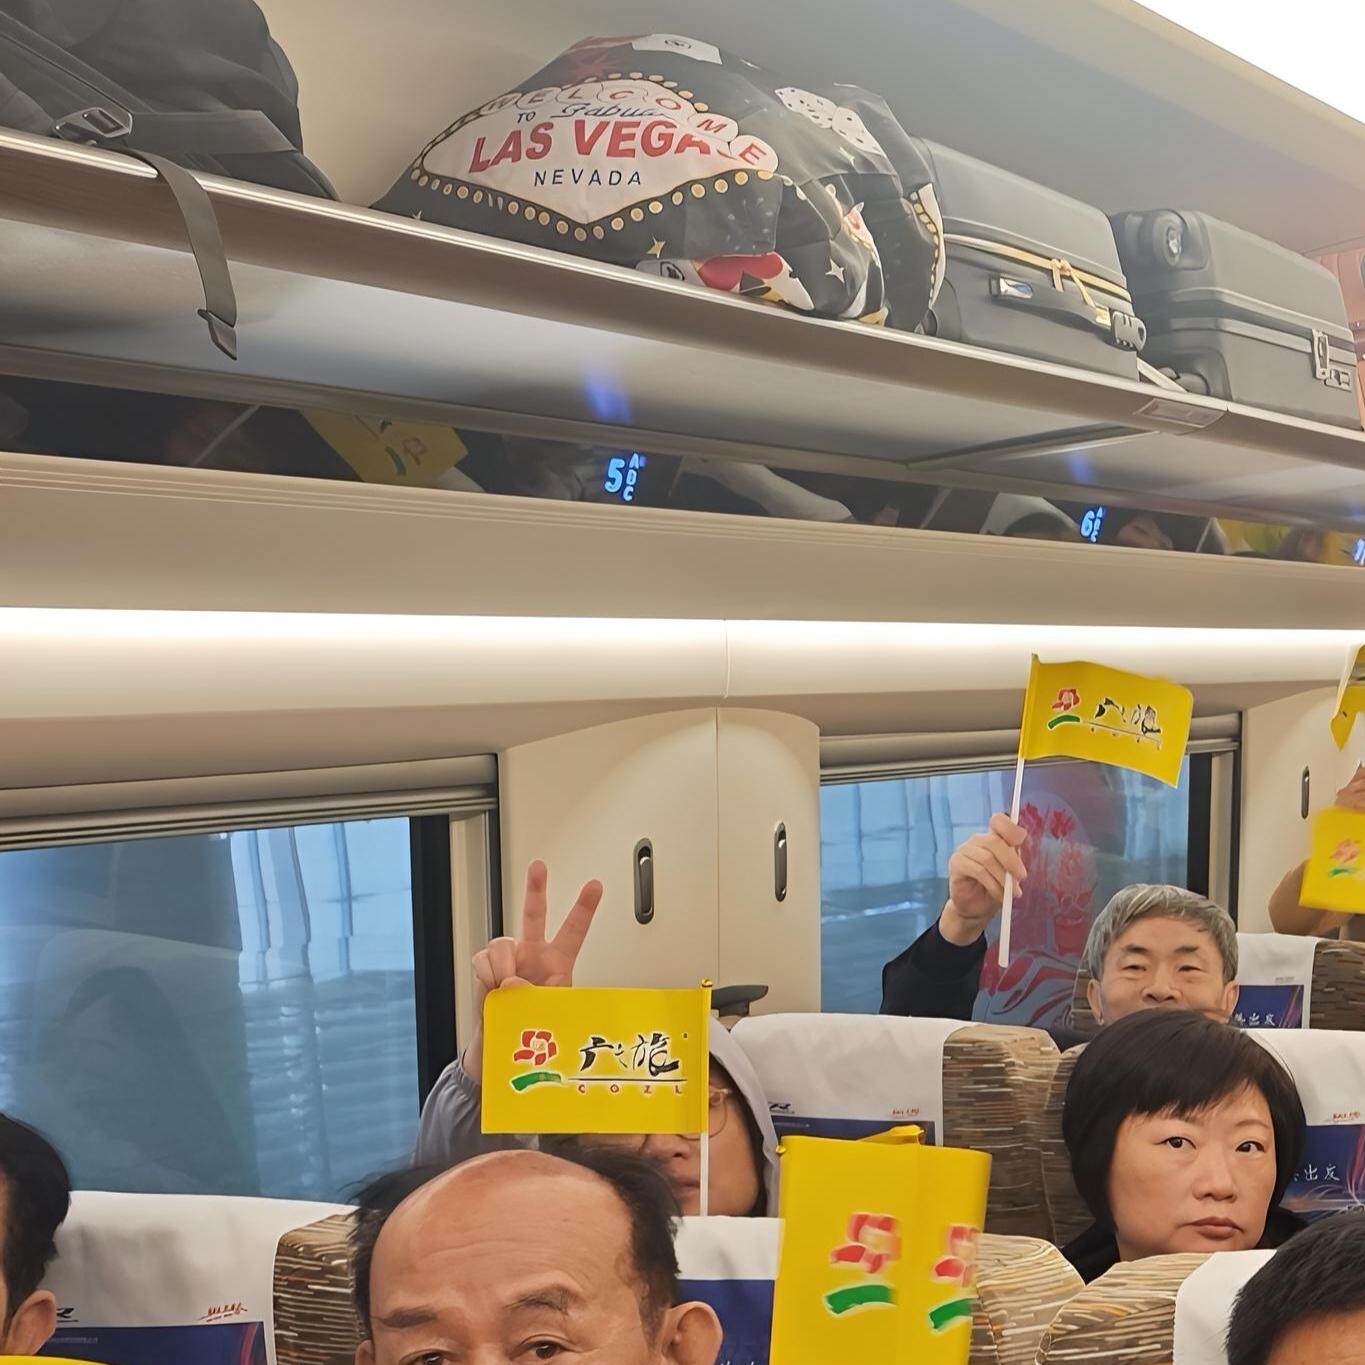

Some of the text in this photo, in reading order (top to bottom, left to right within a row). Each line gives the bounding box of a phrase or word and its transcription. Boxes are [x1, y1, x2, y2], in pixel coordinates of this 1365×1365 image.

[468, 119, 712, 173] LAS VEGA
[534, 169, 641, 187] NEVADA
[604, 458, 625, 493] 5
